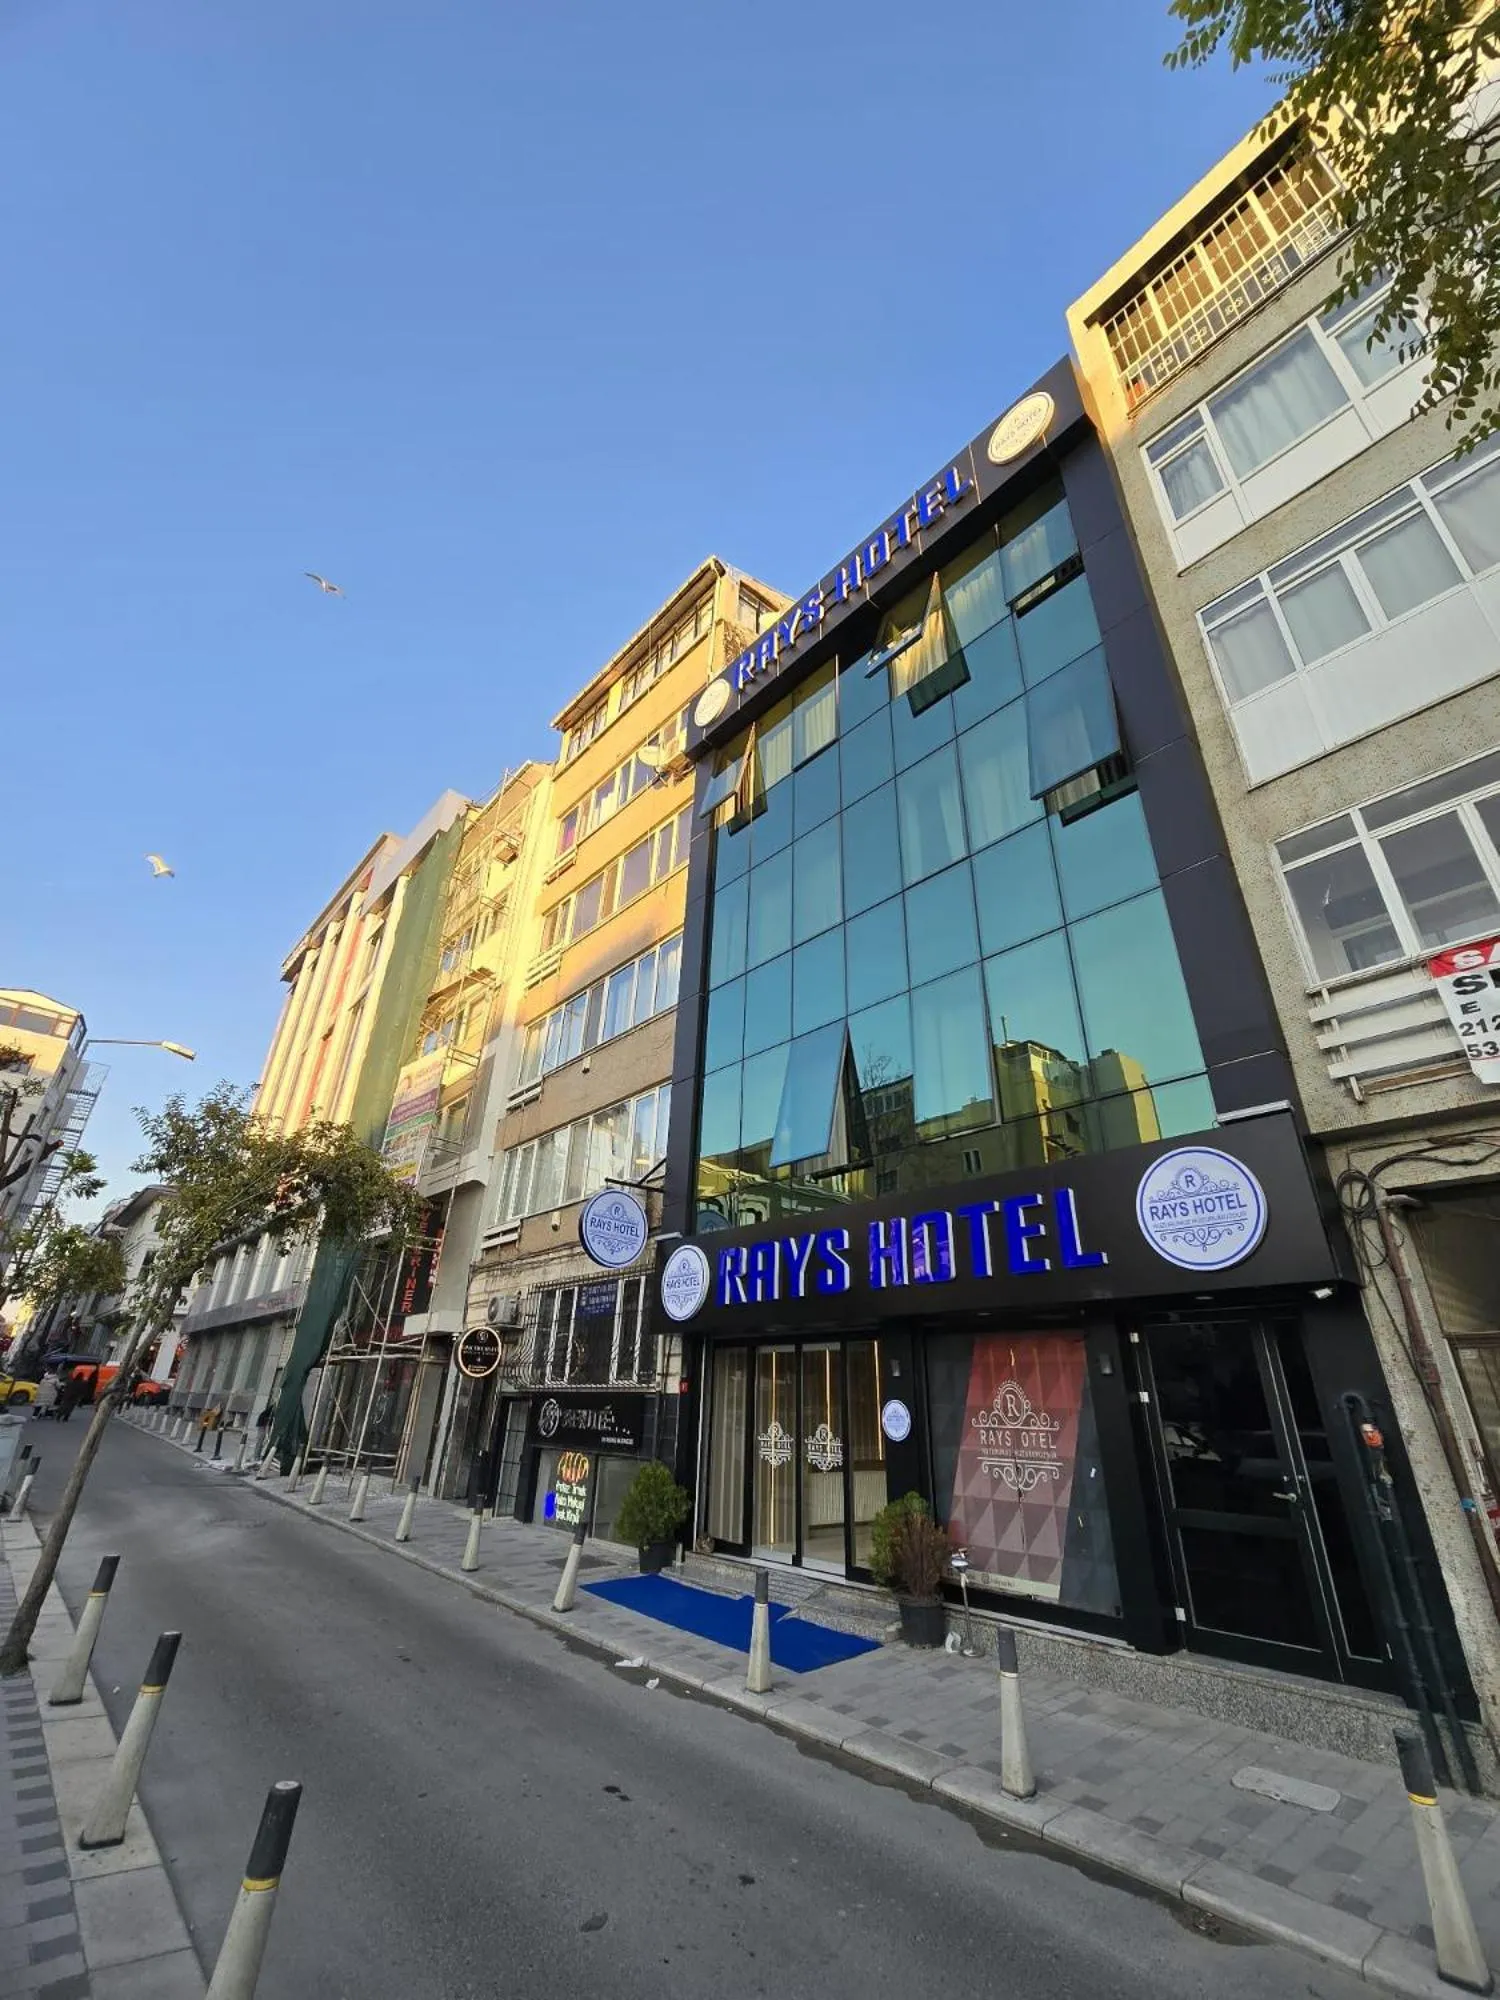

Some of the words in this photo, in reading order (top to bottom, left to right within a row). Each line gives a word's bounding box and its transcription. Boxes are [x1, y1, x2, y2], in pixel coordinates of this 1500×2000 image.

[733, 590, 825, 692] RAYS
[834, 466, 974, 604] HOTEL
[1185, 1174, 1196, 1188] R
[1149, 1201, 1190, 1221] RAYS
[1193, 1193, 1248, 1215] HOTEL
[590, 1217, 612, 1231] RAYS
[614, 1222, 640, 1238] HOTEL
[715, 1229, 850, 1306] RAYS
[868, 1186, 1110, 1291] HOTEL
[666, 1279, 681, 1289] RAYS
[1006, 1394, 1021, 1417] R
[980, 1429, 1012, 1447] RAYS
[1021, 1431, 1057, 1449] OTEL
